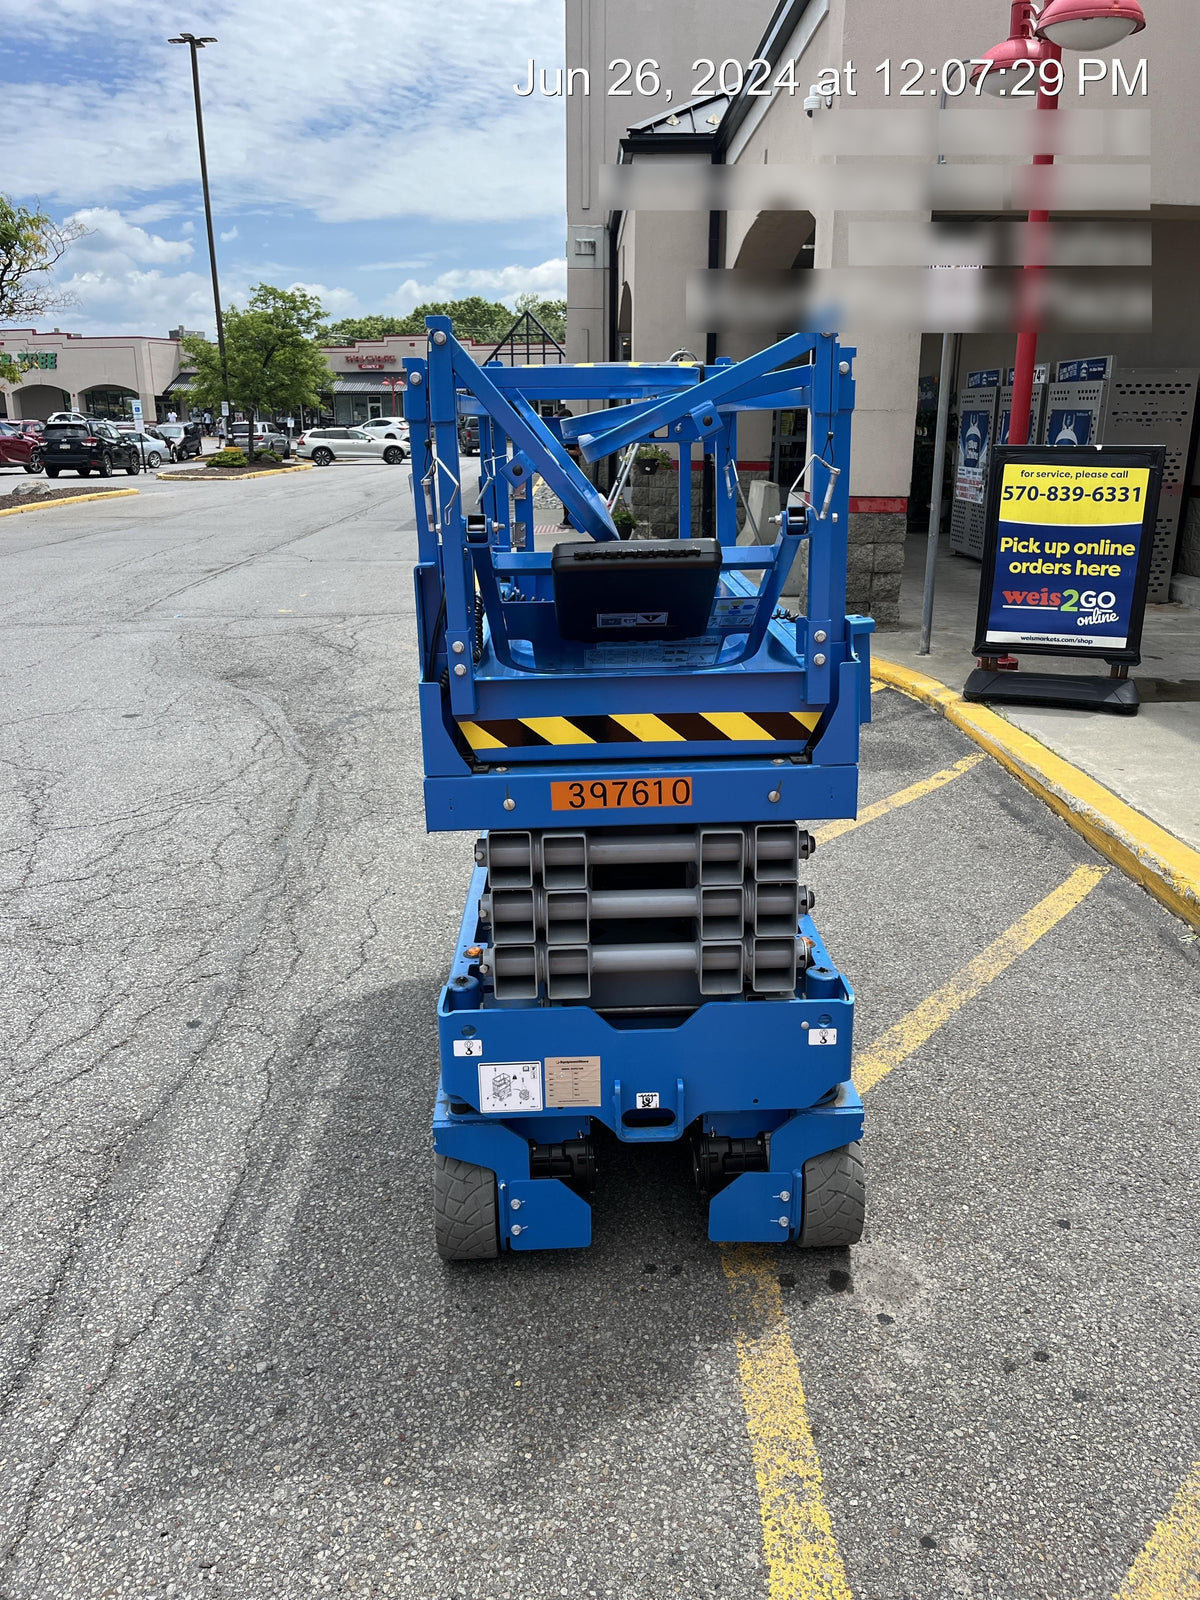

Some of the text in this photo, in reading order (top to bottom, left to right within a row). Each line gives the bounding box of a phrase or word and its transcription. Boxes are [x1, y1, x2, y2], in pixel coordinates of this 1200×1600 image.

[1020, 470, 1129, 480] for service, please call
[1002, 485, 1142, 503] 570-839-6331
[1000, 537, 1136, 558] Pick up online
[1008, 558, 1121, 577] orders here
[1076, 608, 1119, 626] online
[1020, 634, 1094, 645] weismarkets.com/shop
[568, 778, 691, 809] 397610
